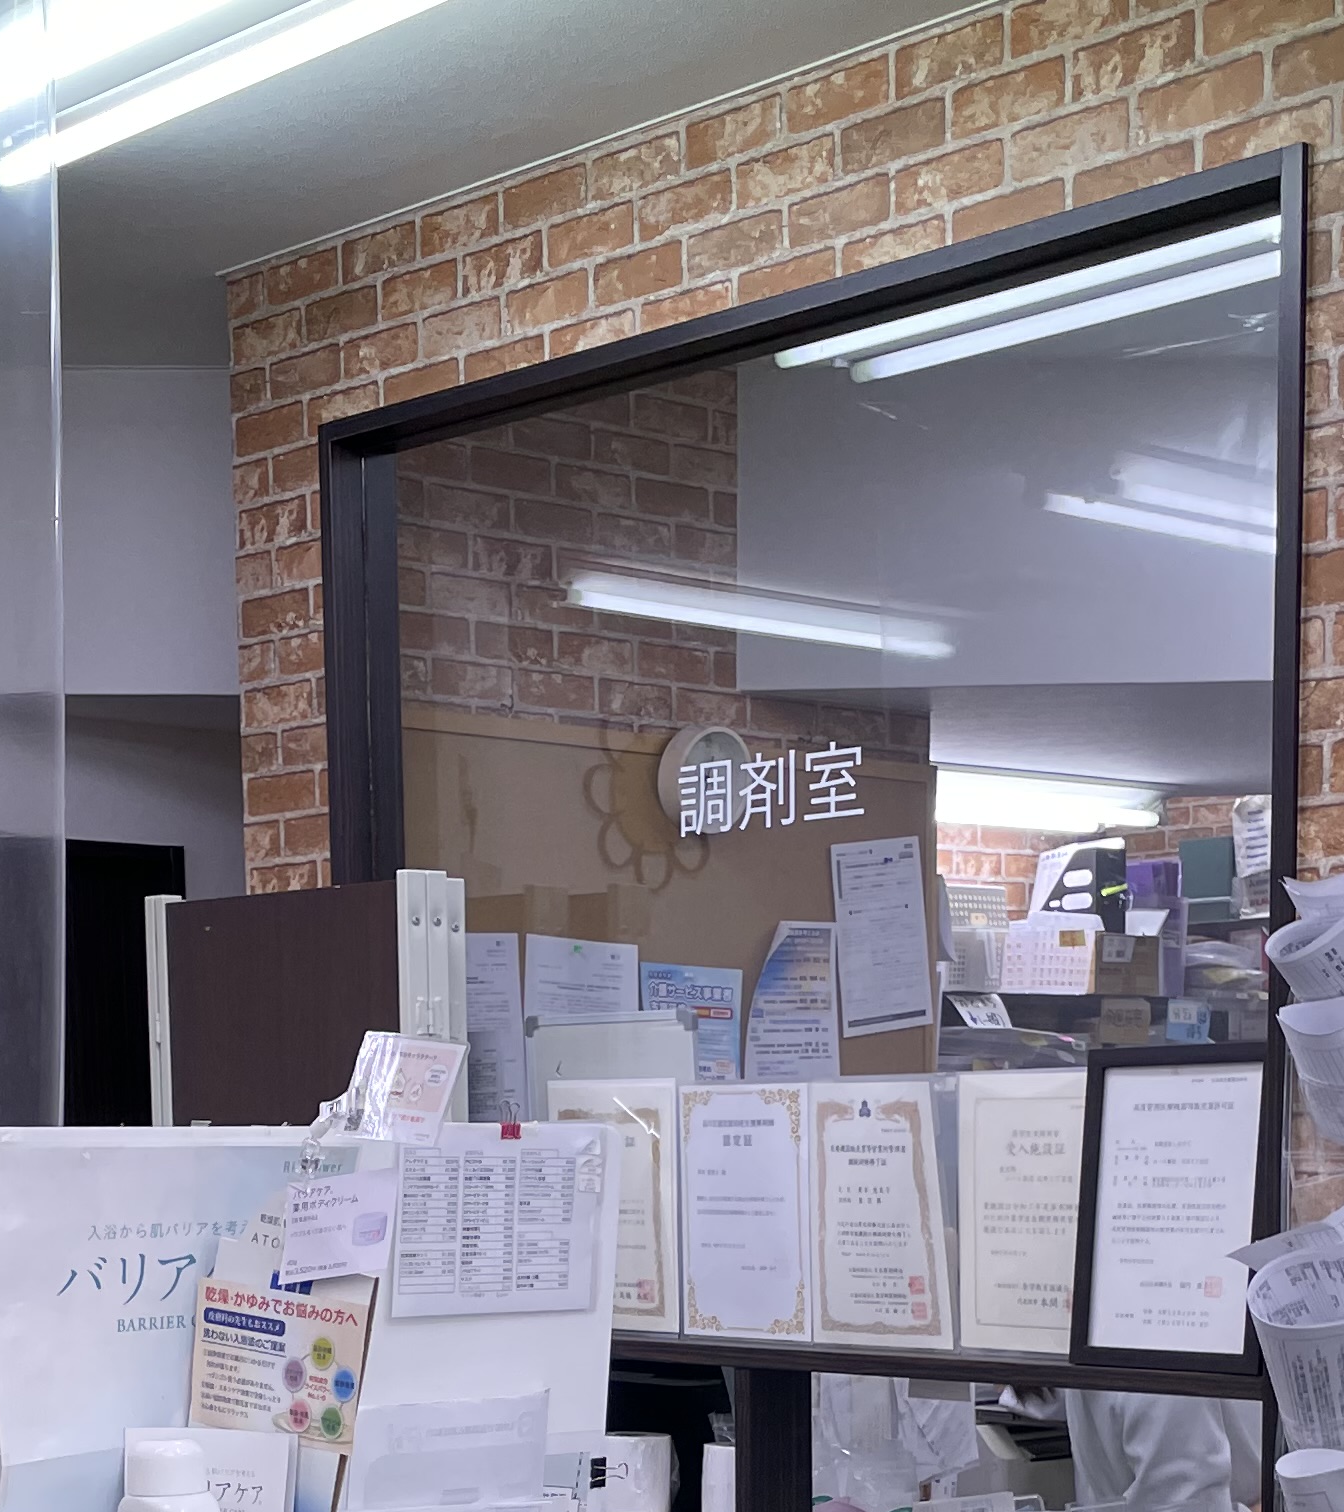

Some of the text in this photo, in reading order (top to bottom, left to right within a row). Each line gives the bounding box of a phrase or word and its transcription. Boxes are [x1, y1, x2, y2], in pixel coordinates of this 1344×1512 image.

[677, 742, 867, 839] 調剤室
[56, 1253, 215, 1306] バリア
[117, 1315, 186, 1333] BARRIER
